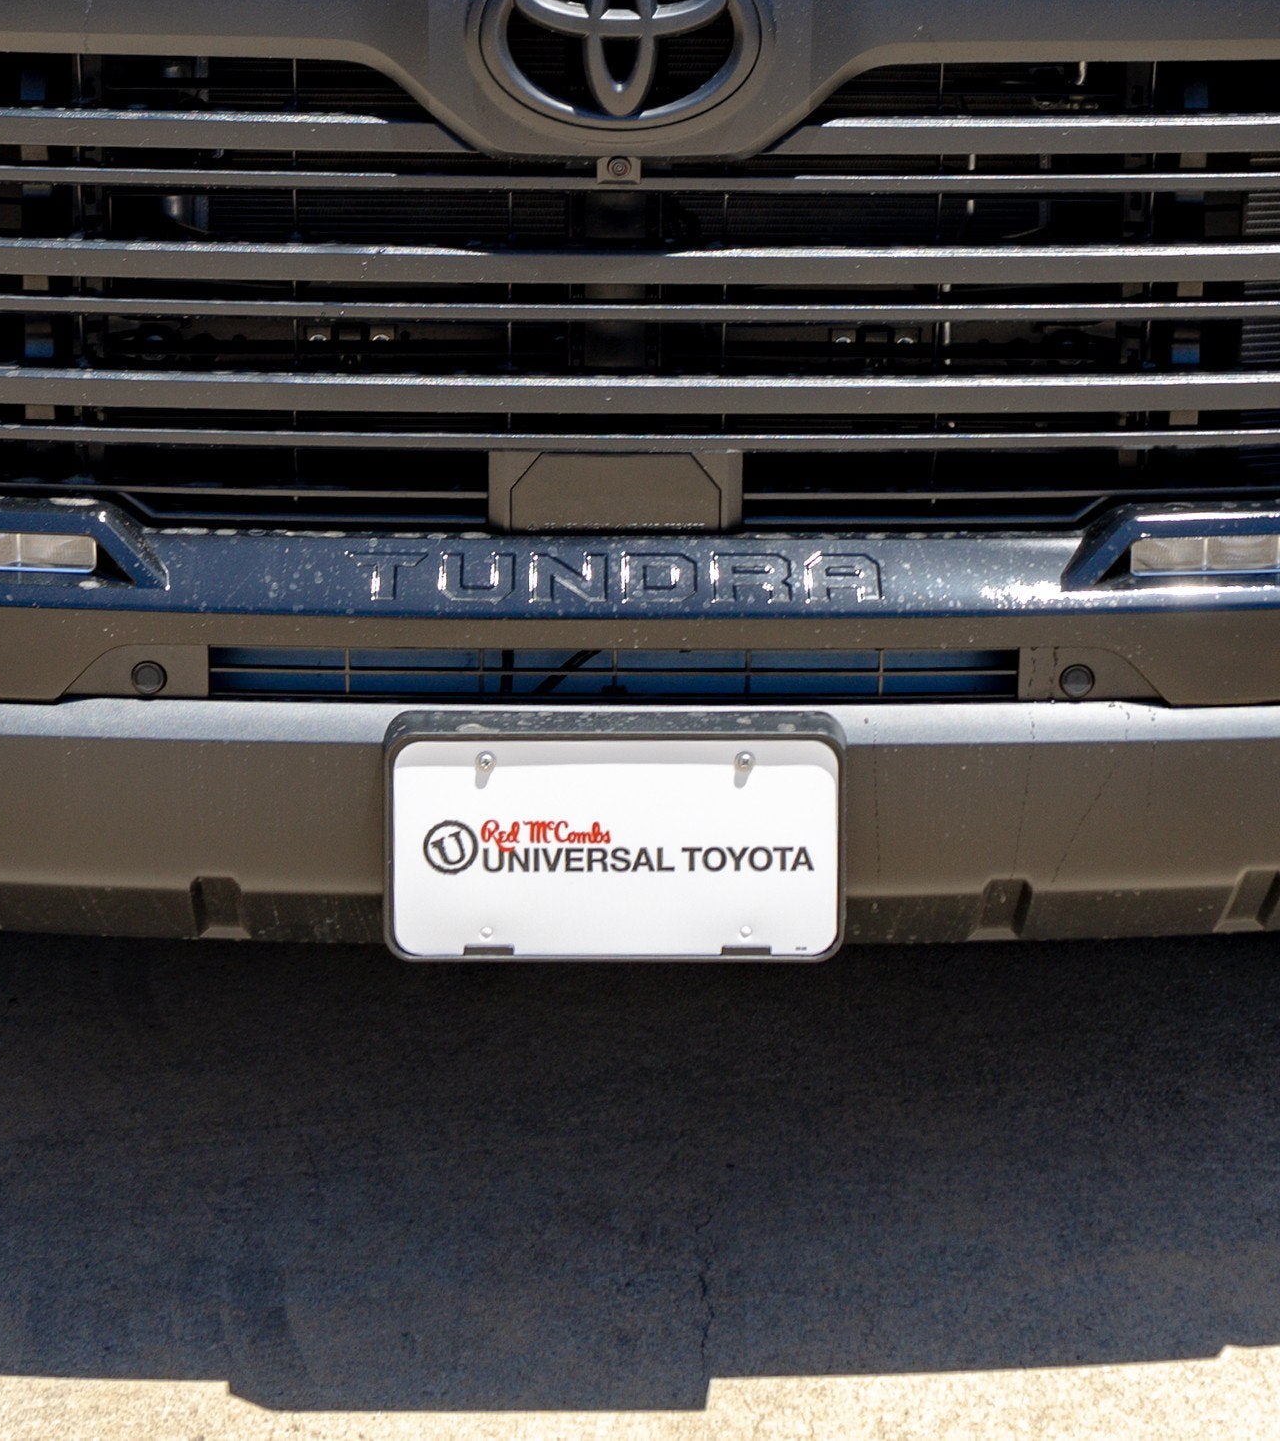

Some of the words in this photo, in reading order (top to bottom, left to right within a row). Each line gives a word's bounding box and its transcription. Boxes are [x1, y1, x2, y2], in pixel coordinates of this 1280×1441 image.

[343, 549, 886, 604] TUNDRA
[480, 819, 521, 853] Red
[523, 820, 612, 845] McCombs
[482, 847, 676, 873] UNIVERSAL
[681, 846, 815, 873] TOYOTA
